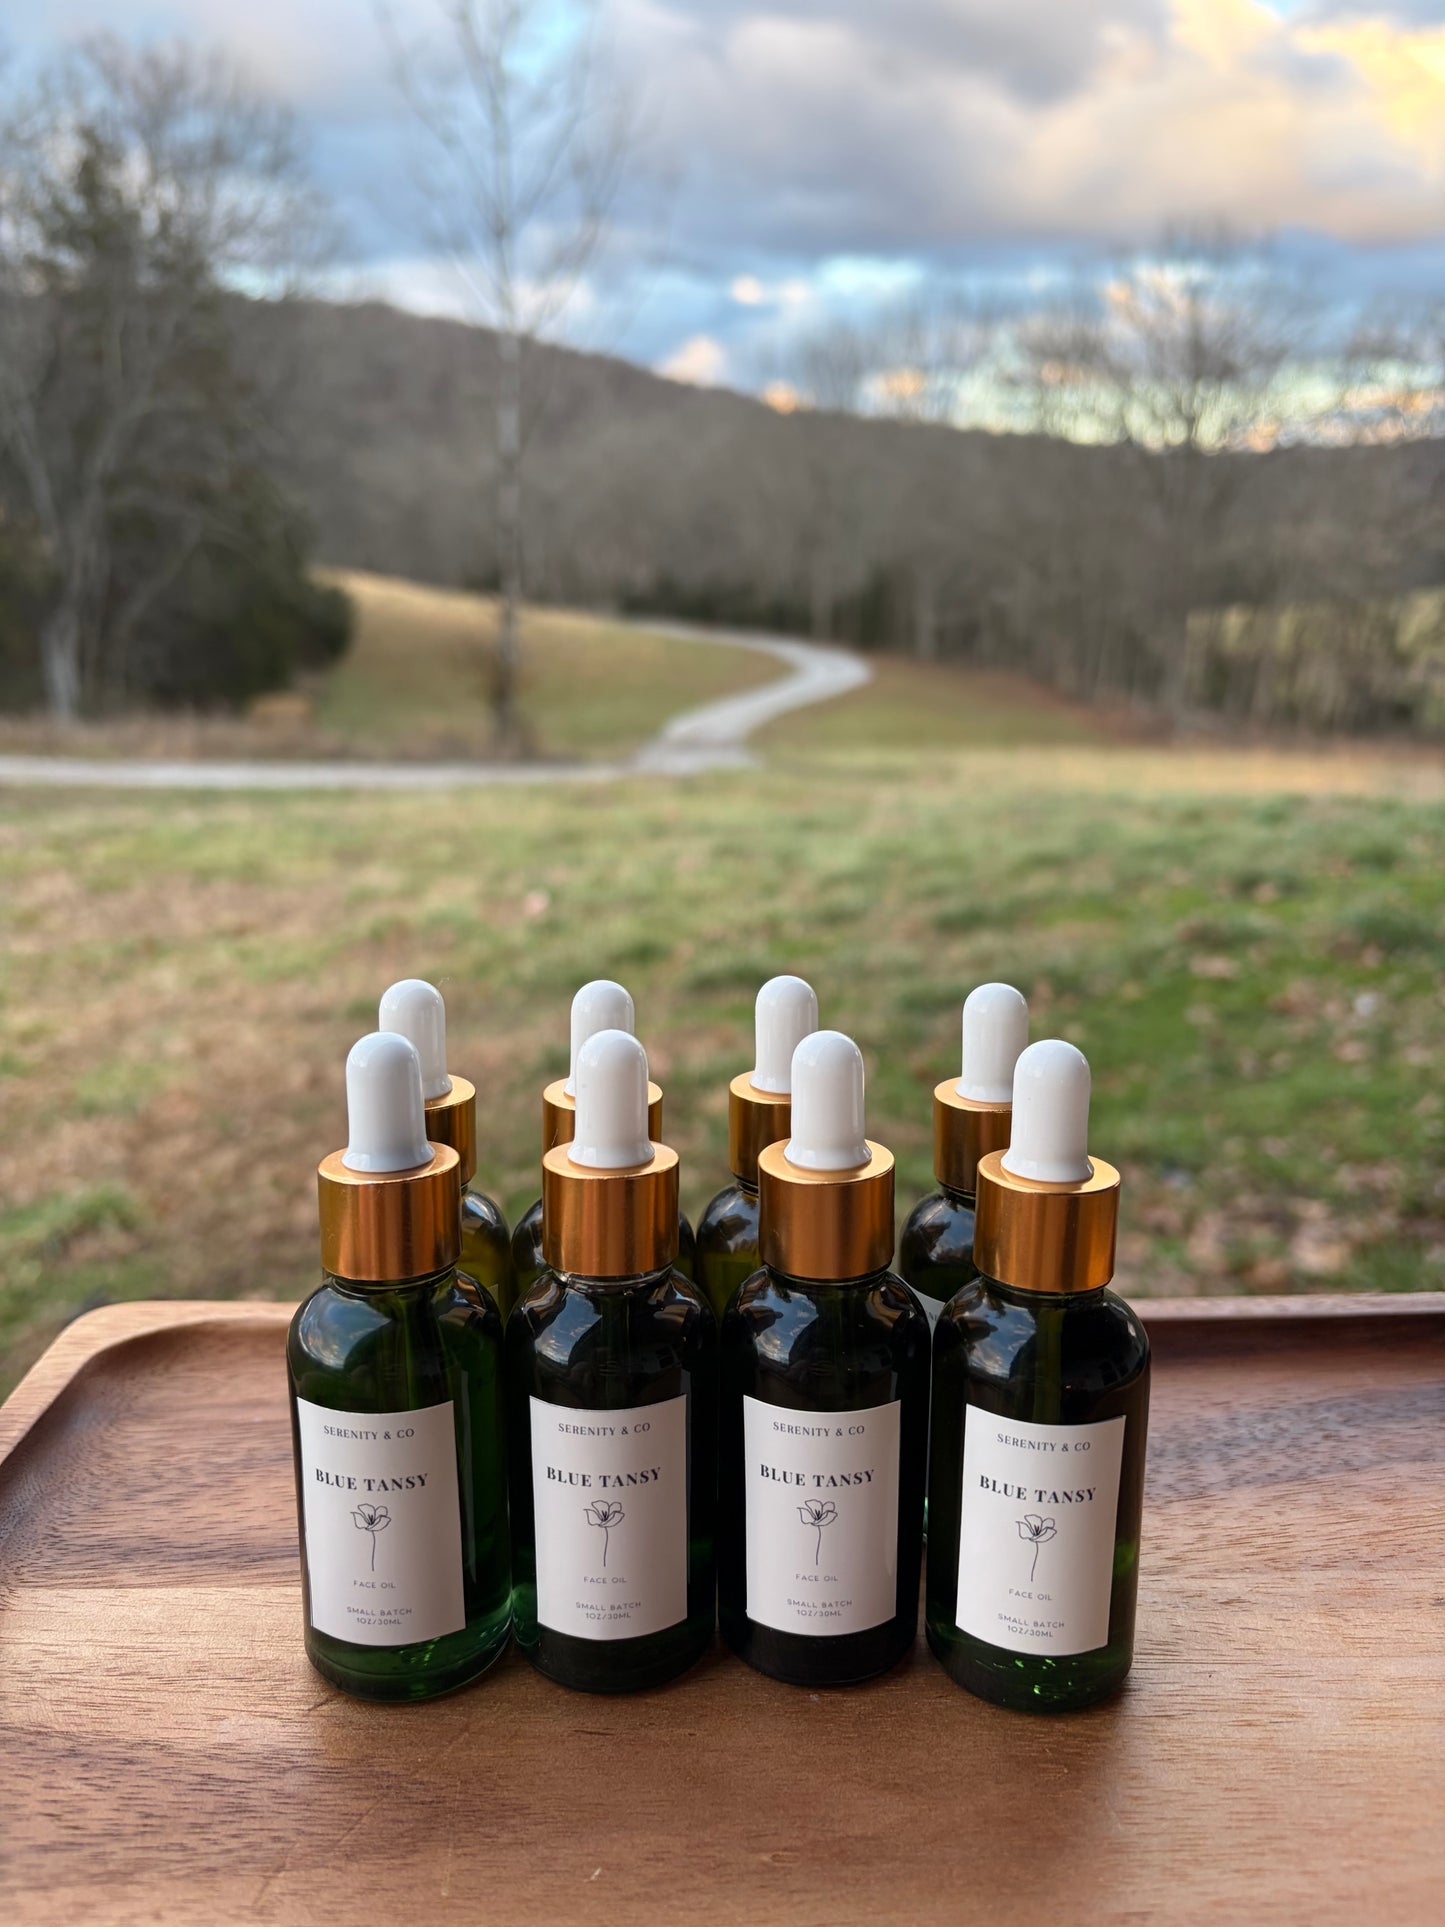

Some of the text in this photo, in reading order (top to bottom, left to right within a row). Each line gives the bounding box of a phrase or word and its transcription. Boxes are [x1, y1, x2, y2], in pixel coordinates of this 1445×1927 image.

[323, 1424, 415, 1440] SERENITY & CO
[558, 1422, 651, 1437] SERENITY & CO
[772, 1421, 865, 1437] SERENITY & CO
[997, 1433, 1091, 1452] SERENITY & CO
[315, 1468, 429, 1492] BLUE TANSY
[547, 1466, 661, 1488] BLUE TANSY
[760, 1464, 875, 1488] BLUE TANSY
[979, 1474, 1097, 1504] BLUE TANSY
[353, 1579, 396, 1589] FACE OIL
[583, 1576, 627, 1584] FACE OIL
[795, 1573, 819, 1582] FACE
[1008, 1588, 1053, 1601] FACE OIL
[575, 1601, 642, 1611] SMALL BATCH
[787, 1598, 852, 1609] SMALL BATCH
[347, 1606, 412, 1616] SMALL BATCH
[585, 1611, 632, 1620] 1OZ/30ML
[797, 1609, 843, 1617] 1OZ/30ML
[356, 1617, 403, 1626] 1OZ/30ML
[997, 1612, 1065, 1629] SMALL BATCH
[1007, 1624, 1054, 1638] 1OZ/30ML
